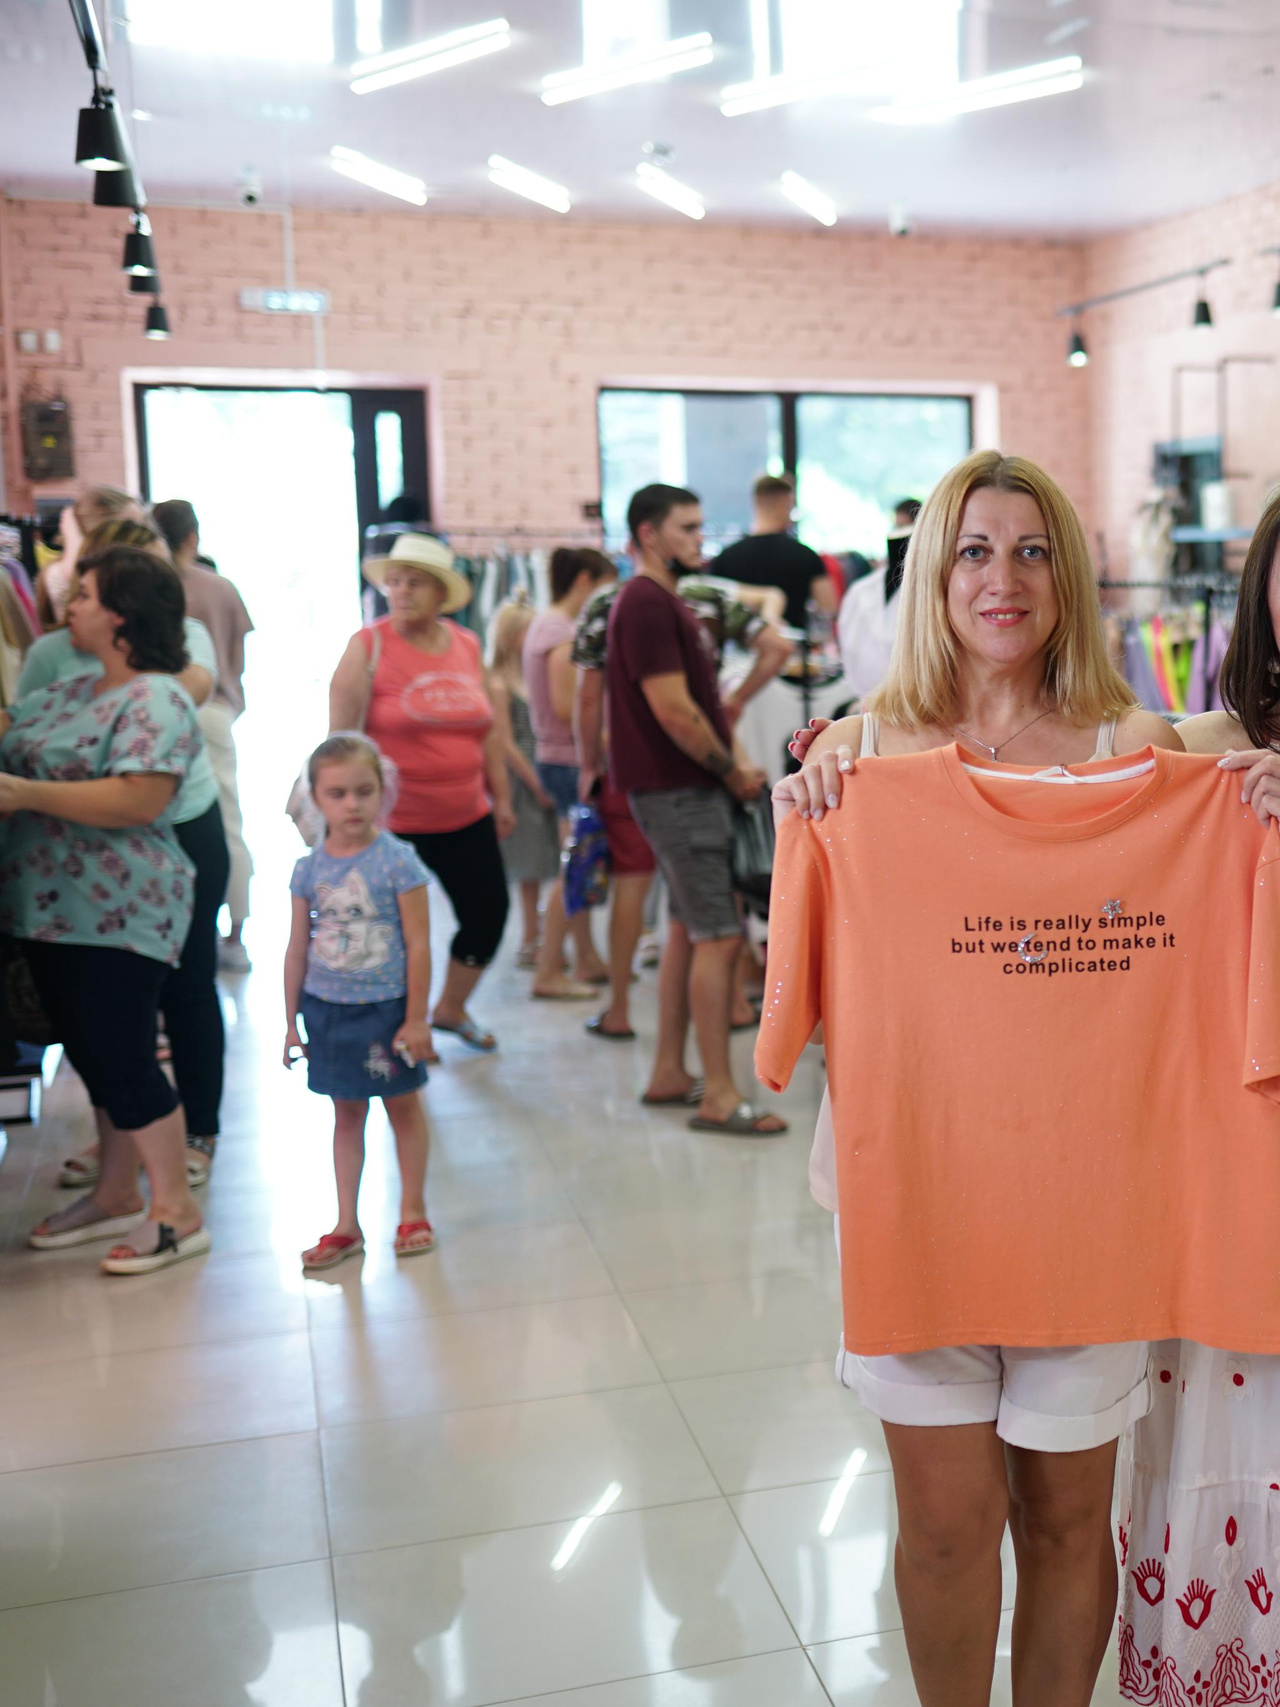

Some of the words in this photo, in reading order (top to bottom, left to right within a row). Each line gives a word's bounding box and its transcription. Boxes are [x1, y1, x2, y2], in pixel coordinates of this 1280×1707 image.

[964, 916, 1003, 932] Life
[1010, 916, 1027, 931] is
[1034, 915, 1092, 933] really
[1098, 911, 1166, 931] simple
[951, 938, 985, 953] but
[991, 939, 1018, 953] we
[1025, 936, 1071, 952] tend
[1077, 938, 1096, 951] to
[1103, 934, 1156, 950] make
[1163, 933, 1175, 948] it
[1003, 956, 1131, 977] complicated
